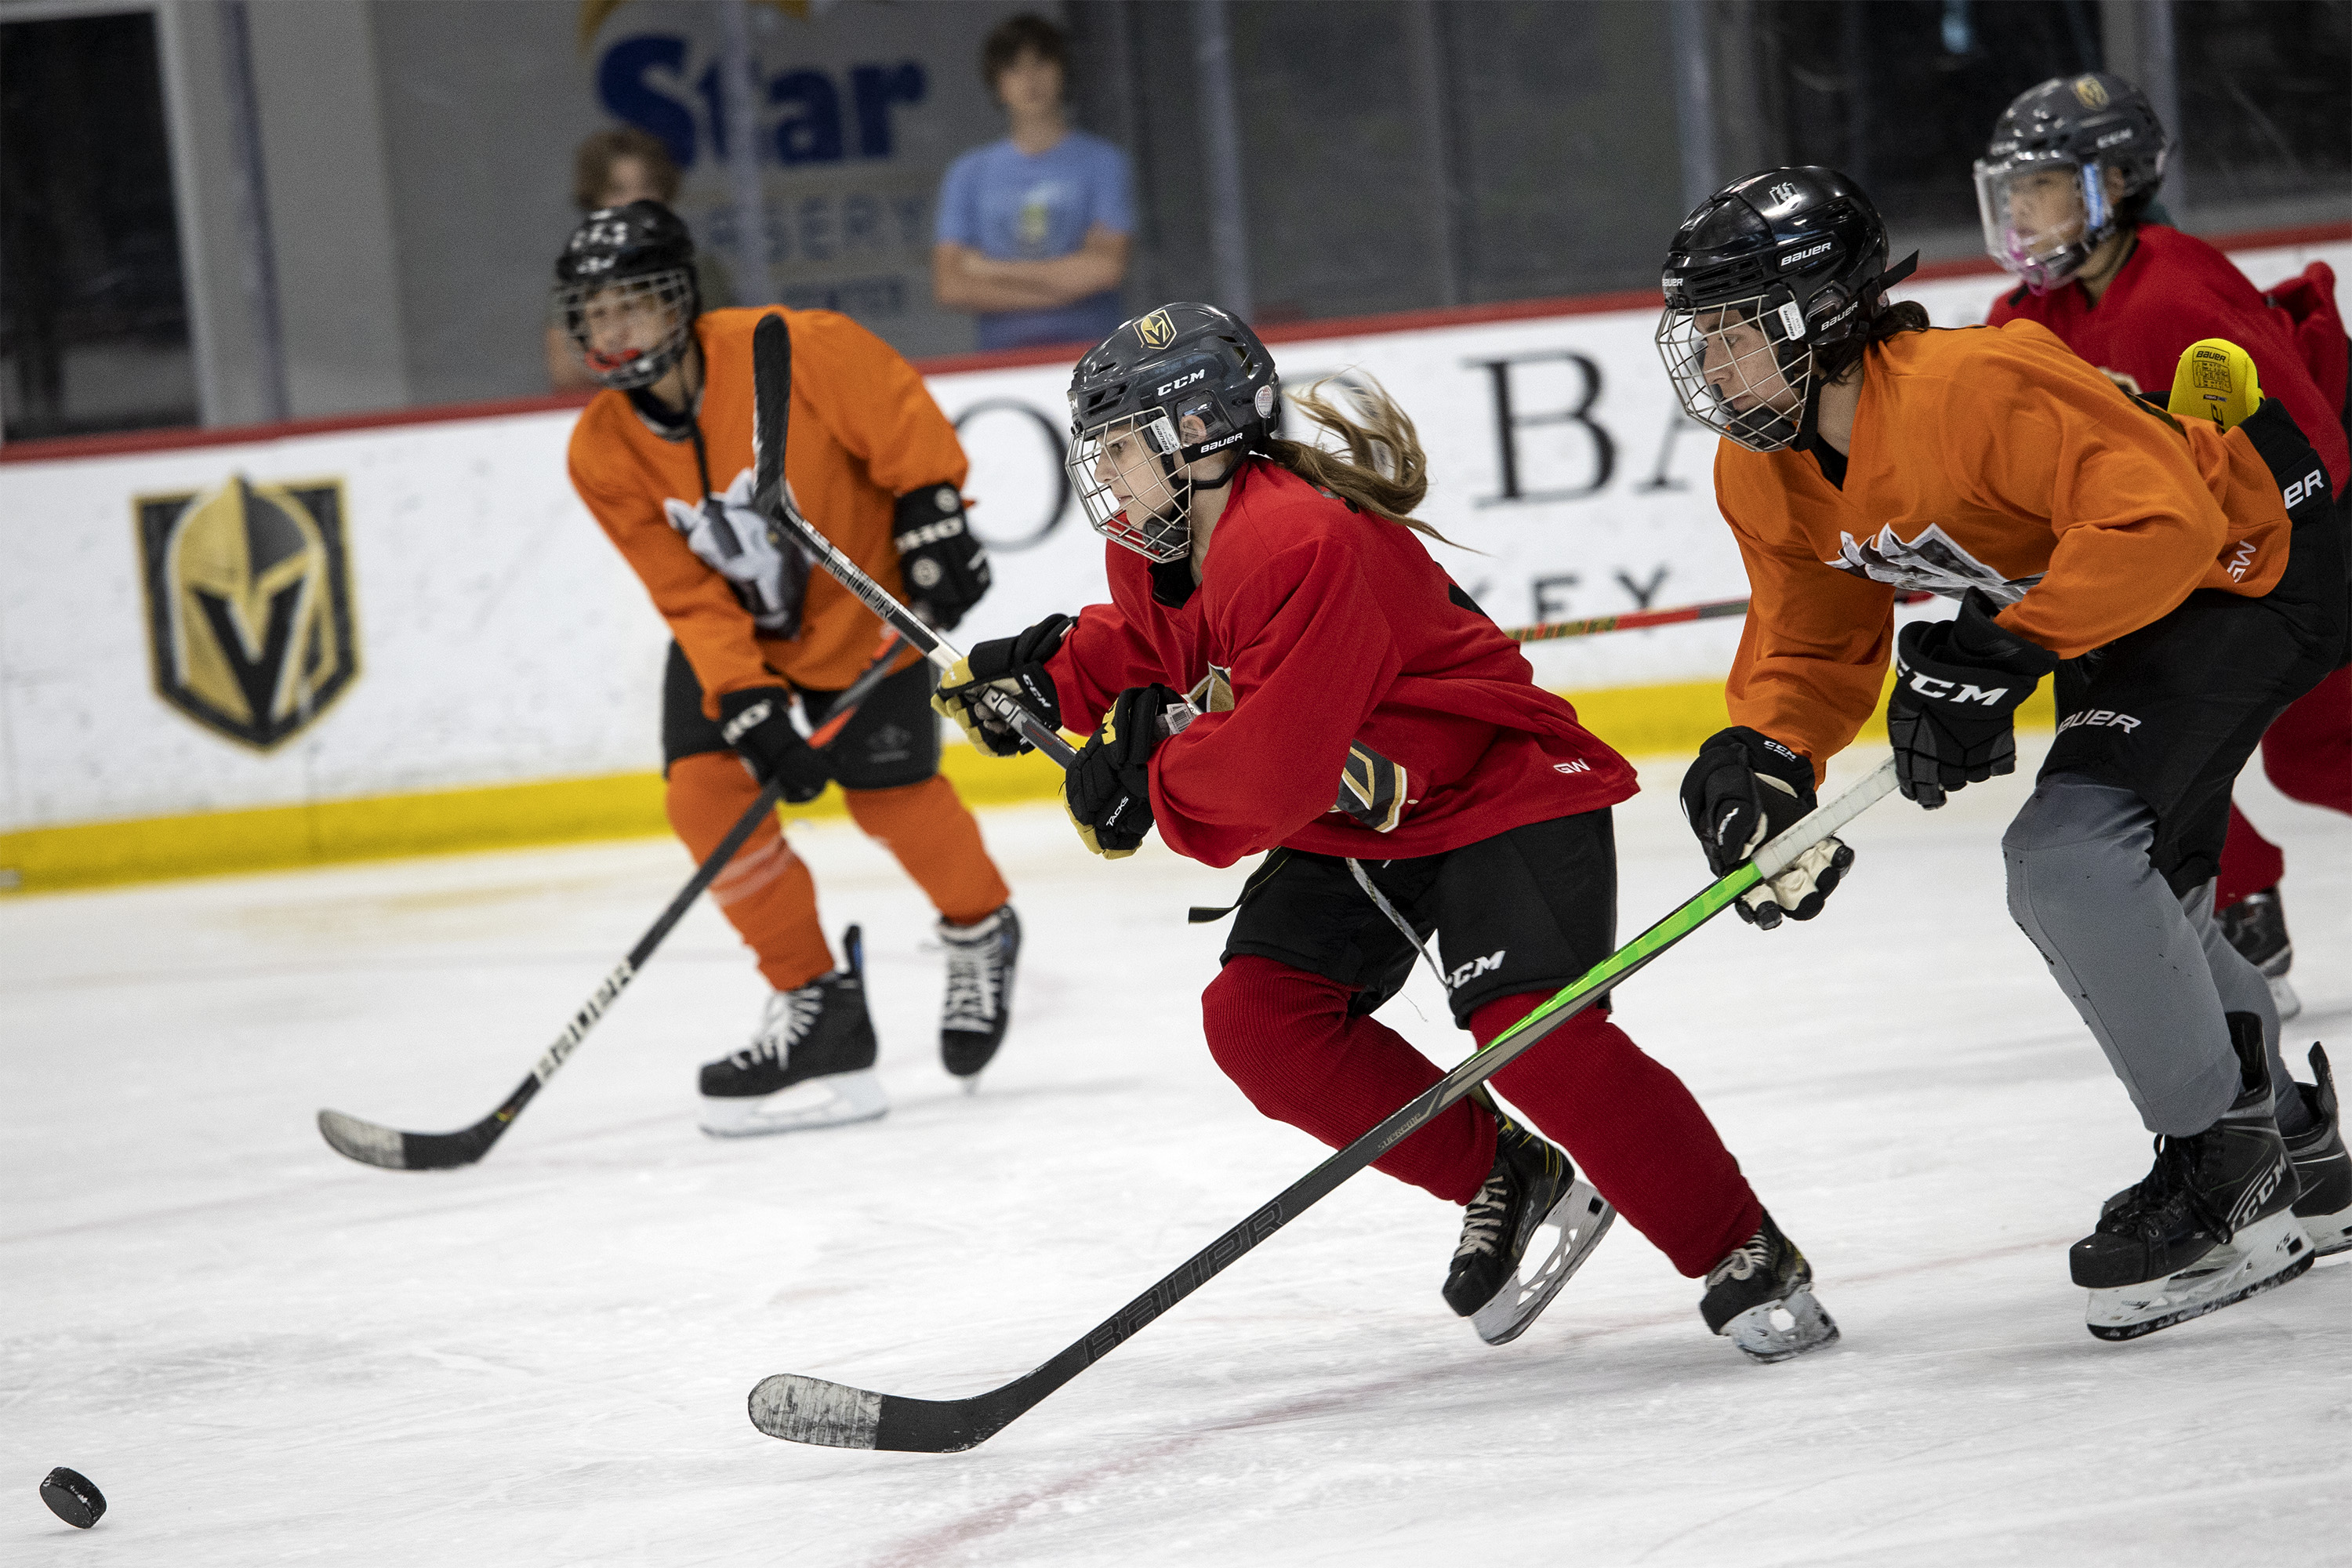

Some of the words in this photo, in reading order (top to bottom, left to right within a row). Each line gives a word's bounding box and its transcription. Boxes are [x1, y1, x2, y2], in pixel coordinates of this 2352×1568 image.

[596, 33, 928, 169] Star
[1780, 241, 1832, 267] BAUER
[1820, 300, 1859, 331] BAUER
[2196, 350, 2227, 363] BAUER
[1157, 368, 1205, 397] CCM
[1200, 432, 1243, 454] BAUER
[2284, 469, 2324, 510] ER
[1022, 673, 1051, 707] CCM
[2056, 708, 2141, 735] AUER
[1763, 739, 1797, 760] CCM
[1553, 757, 1591, 774] GW
[1106, 796, 1129, 827] TACKS
[1377, 1112, 1421, 1151] SUPREME
[2241, 1152, 2287, 1226] CCM
[1083, 1200, 1283, 1367] BAUER
